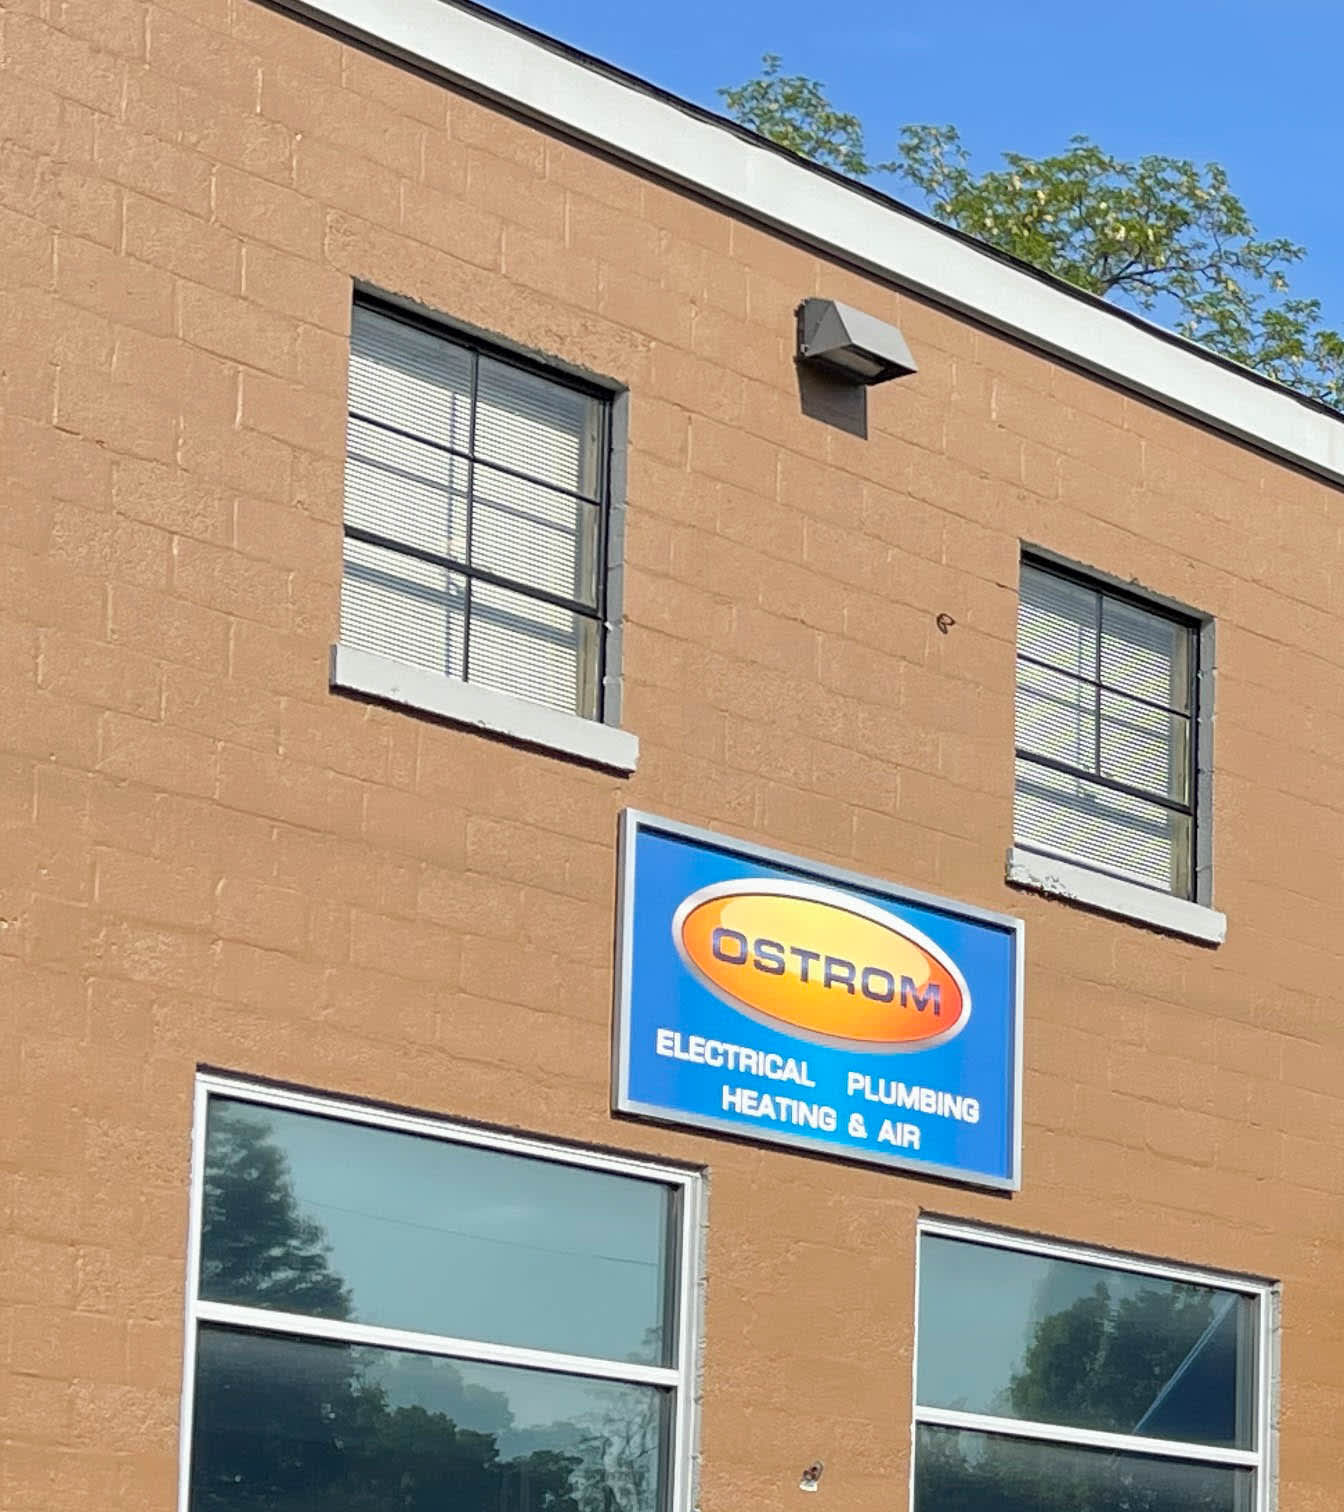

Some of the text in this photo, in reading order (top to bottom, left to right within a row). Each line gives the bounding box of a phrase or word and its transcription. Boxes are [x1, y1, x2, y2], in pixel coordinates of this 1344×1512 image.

[712, 928, 942, 1016] OSTROM
[656, 1028, 980, 1124] ELECTRICAL PLUMBING
[722, 1085, 921, 1150] HEATING & AIR
